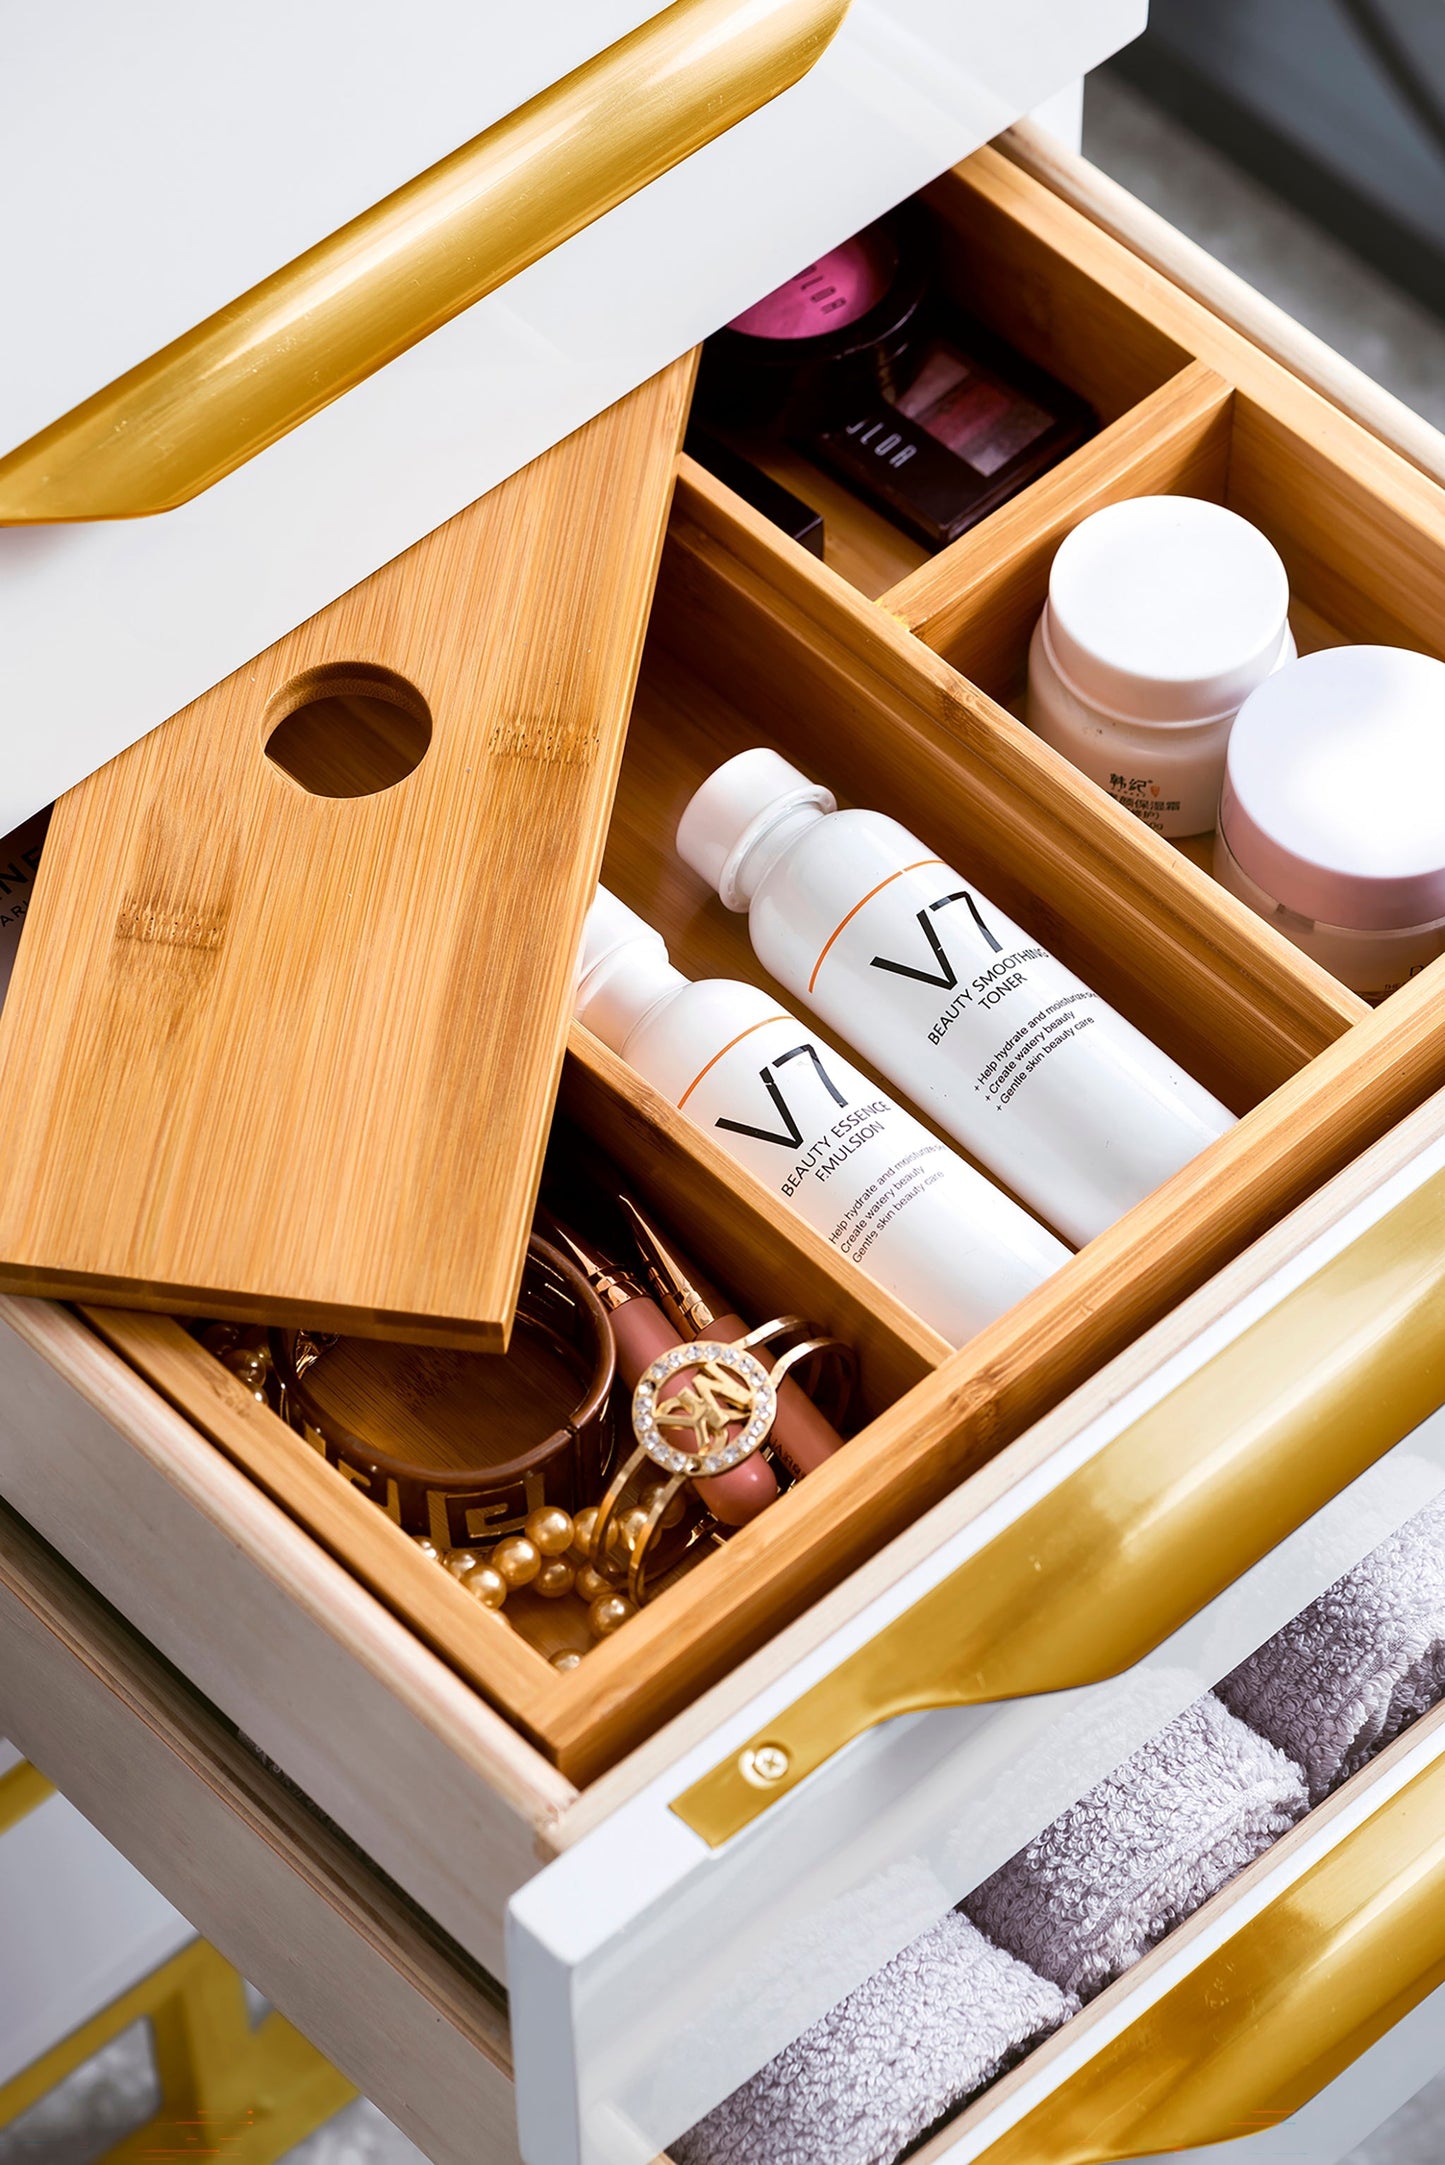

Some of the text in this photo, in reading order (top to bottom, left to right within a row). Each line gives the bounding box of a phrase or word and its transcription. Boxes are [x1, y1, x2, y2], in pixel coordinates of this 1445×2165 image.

[870, 891, 1003, 990] V7
[928, 988, 973, 1045] BEAUTY
[978, 972, 1027, 1010] TONER
[977, 1060, 997, 1085] Help
[994, 1027, 1028, 1061] hydrate
[1027, 1011, 1046, 1028] and
[989, 1010, 1075, 1094] Create watery beauty
[1000, 1017, 1095, 1104] Gentle skin beauty care
[714, 1044, 848, 1149] V7
[781, 1101, 891, 1197] BEAUTY ESSENCE
[828, 1220, 848, 1244] Help
[844, 1184, 878, 1220] hydrate
[877, 1167, 895, 1186] and
[840, 1166, 925, 1254] Create watery beauty
[852, 1171, 944, 1263] Gentle skin beauty care
